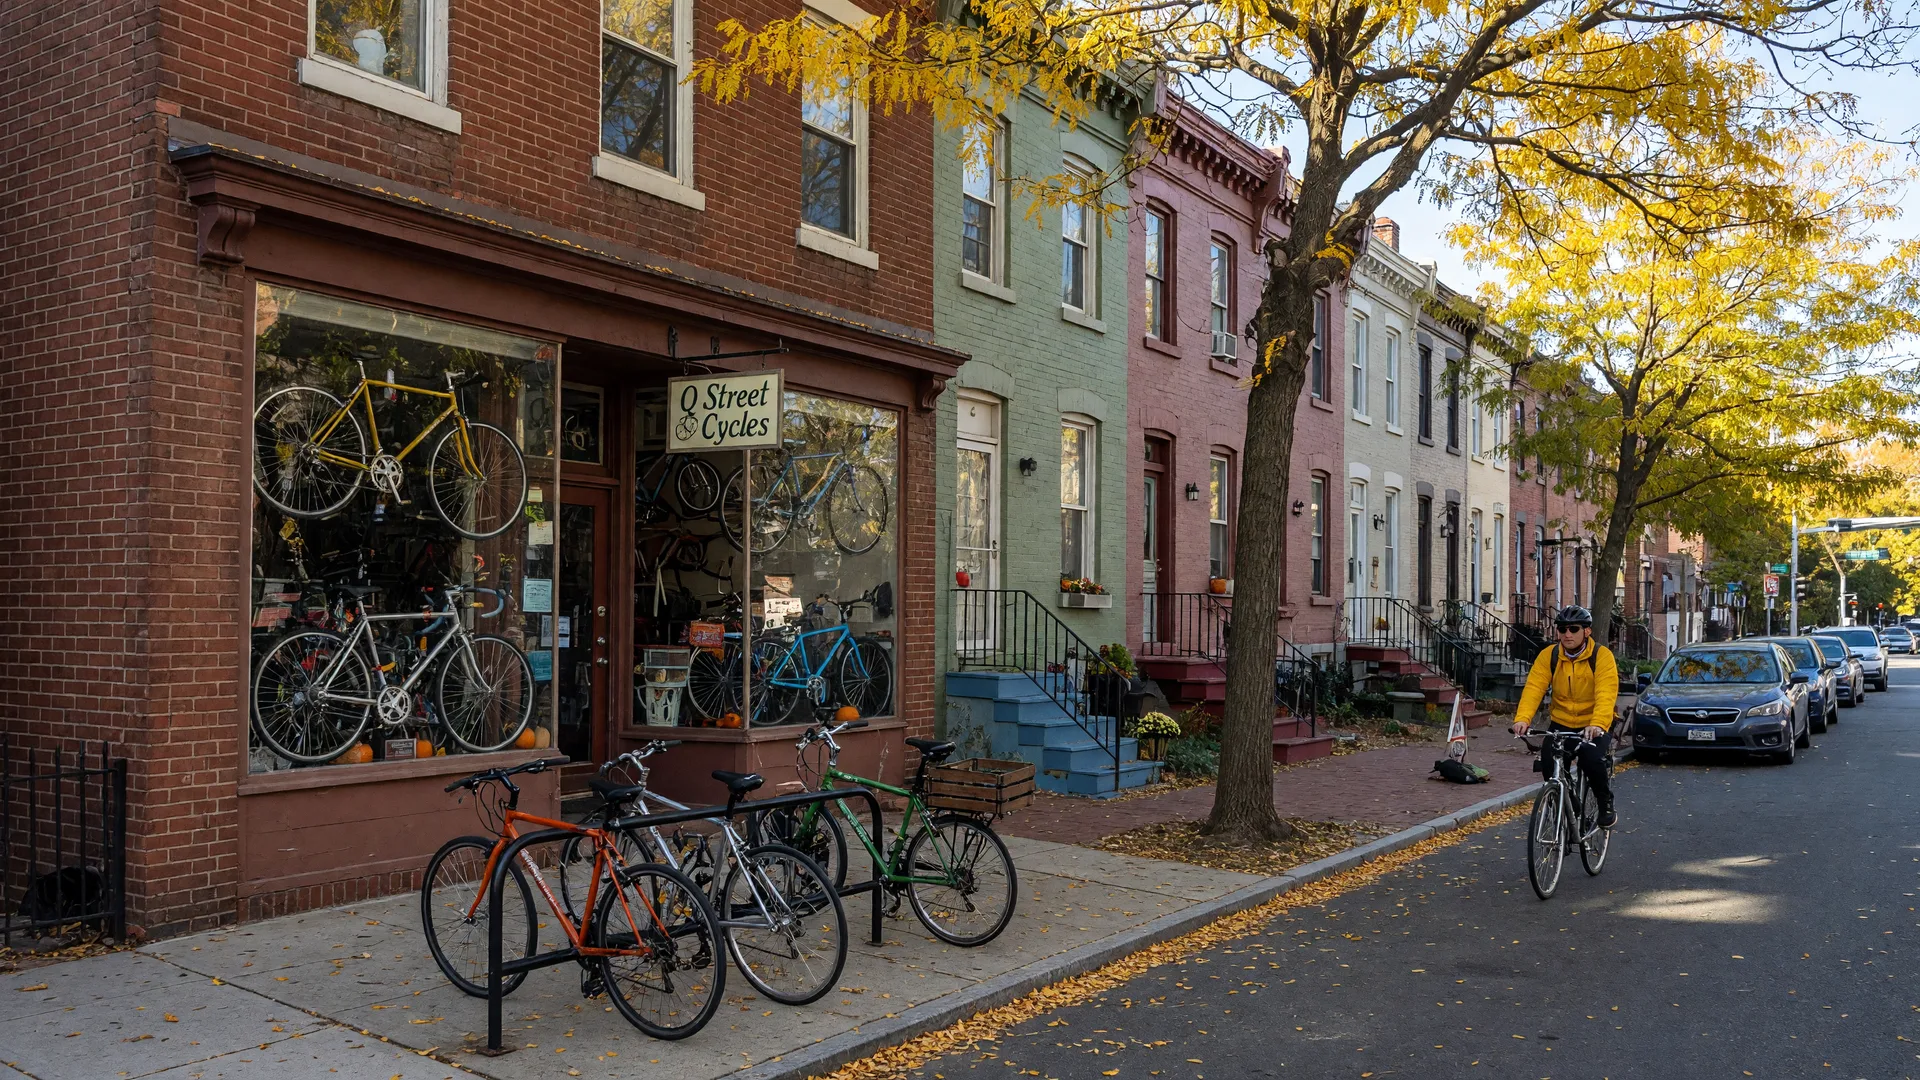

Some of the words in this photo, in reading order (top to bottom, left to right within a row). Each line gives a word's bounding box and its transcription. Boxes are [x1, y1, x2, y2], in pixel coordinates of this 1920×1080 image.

[680, 385, 698, 416] Q
[703, 380, 770, 410] Street
[702, 411, 770, 446] Cycles
